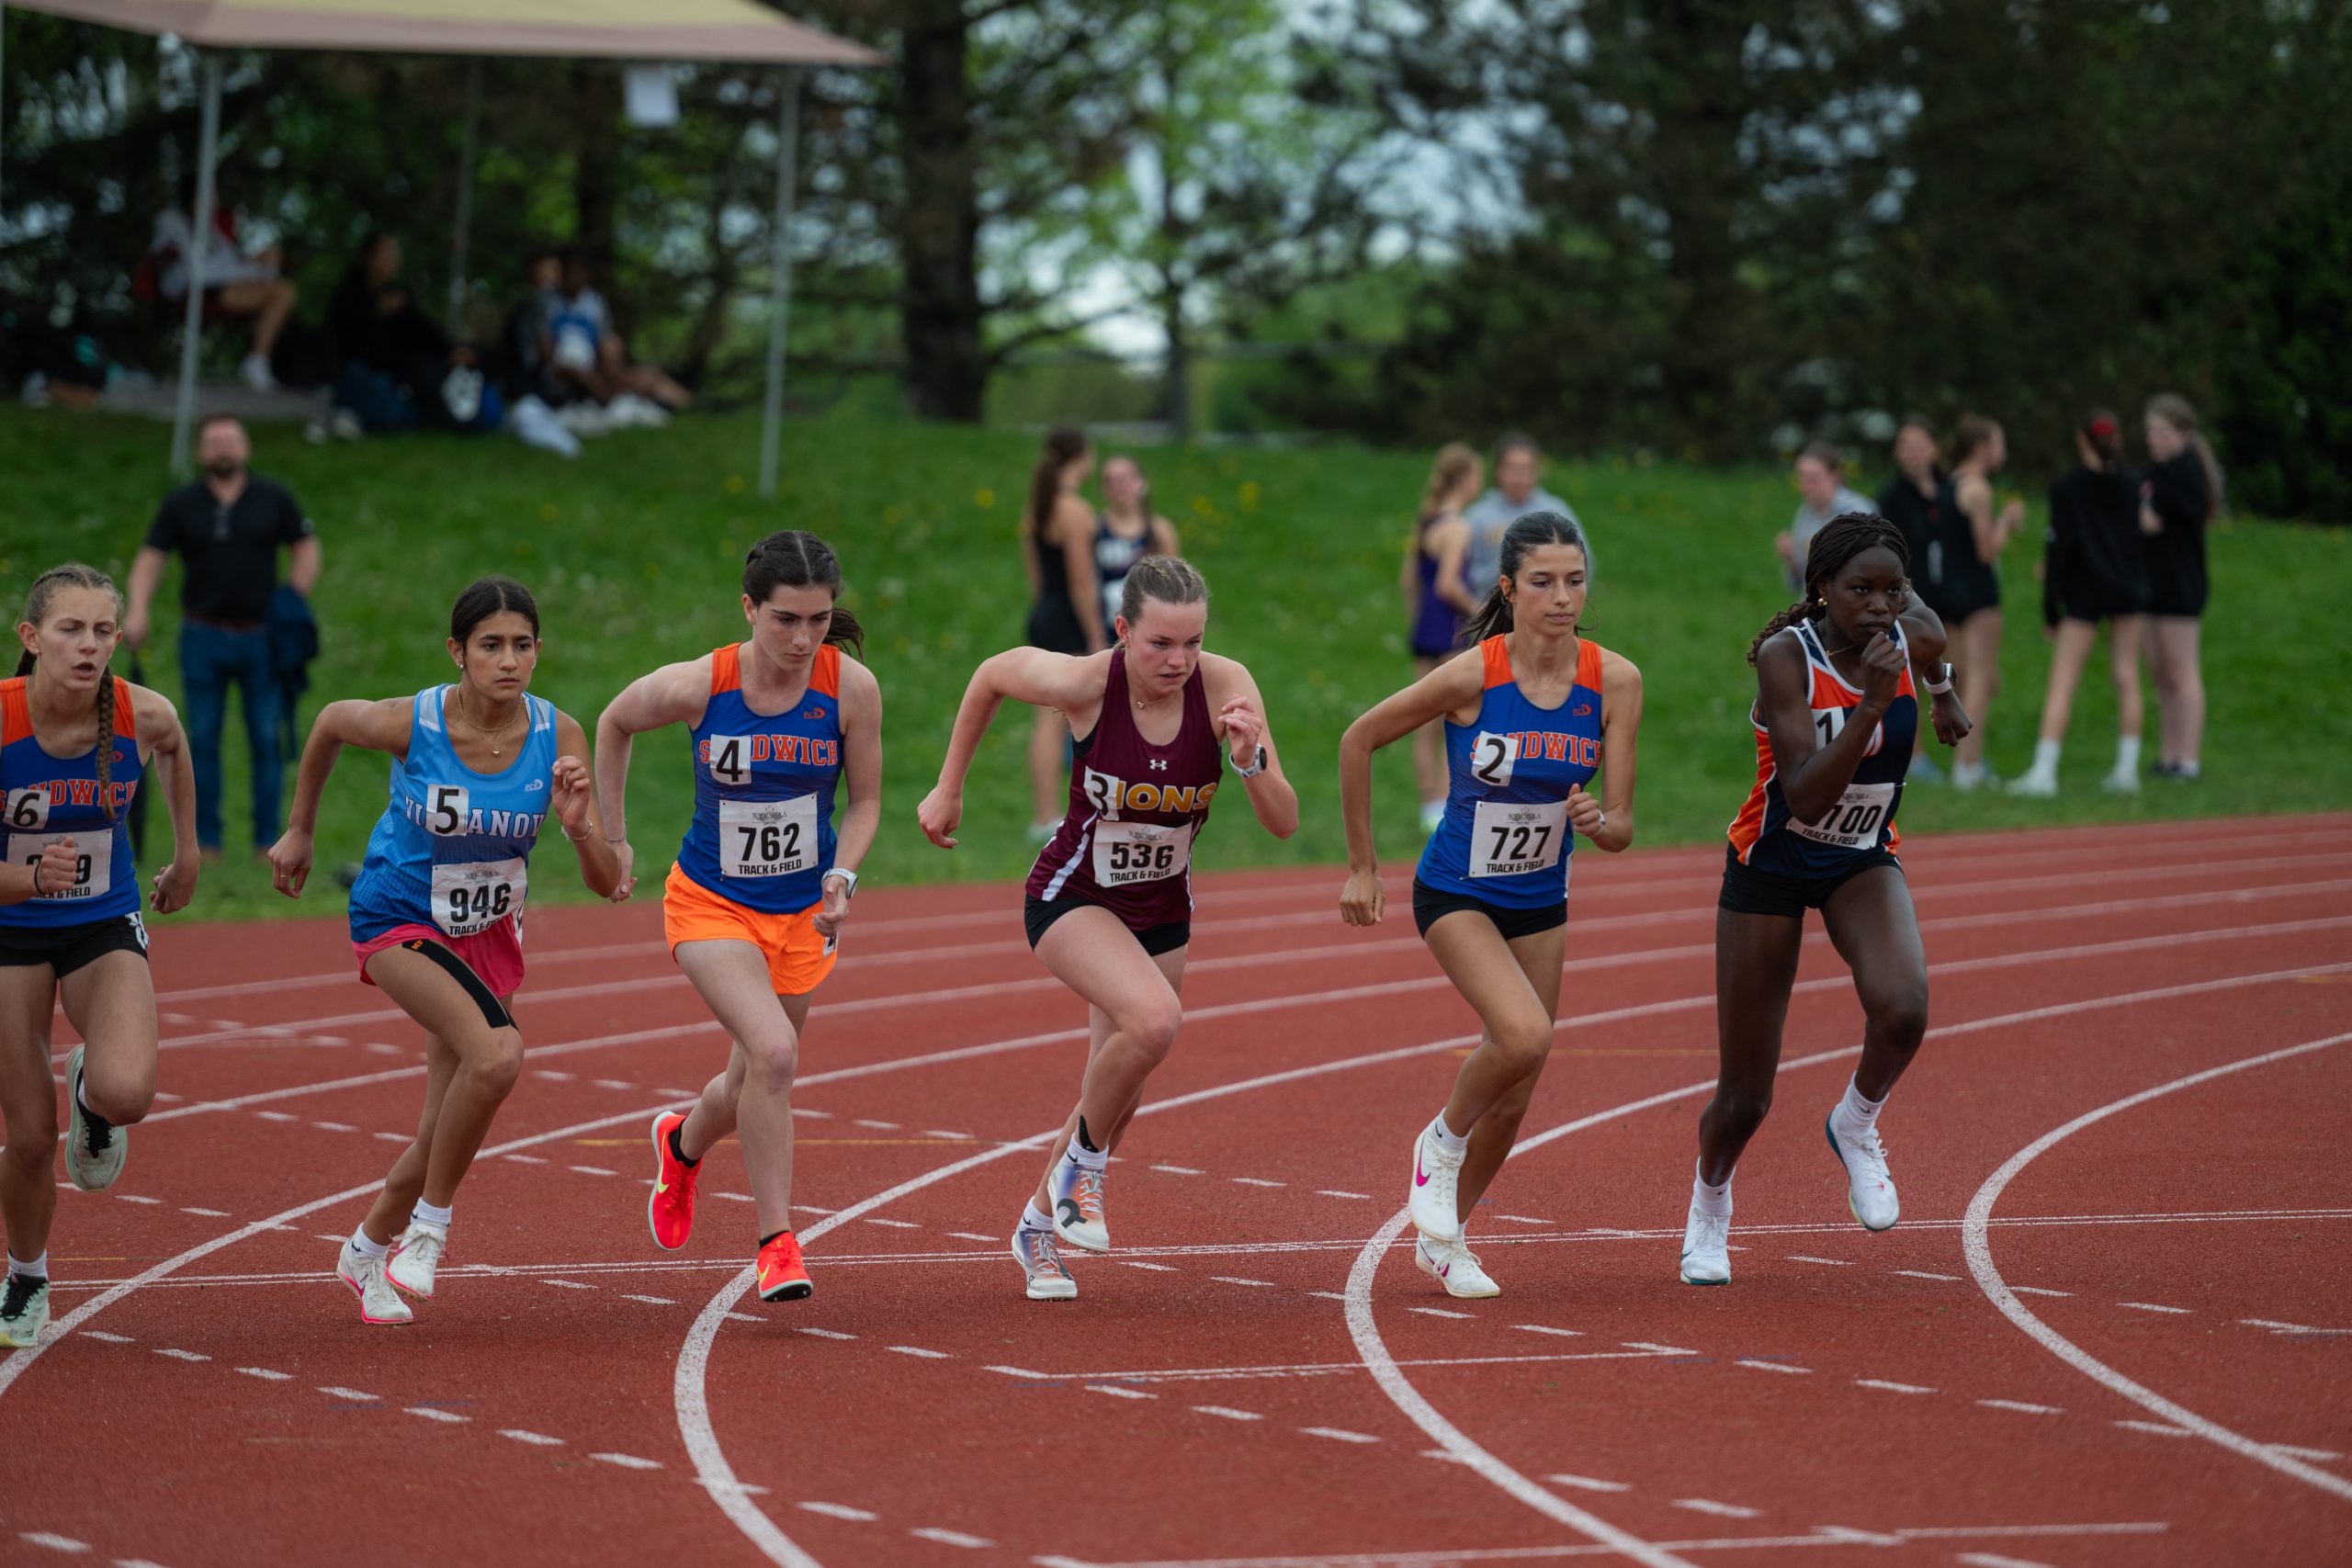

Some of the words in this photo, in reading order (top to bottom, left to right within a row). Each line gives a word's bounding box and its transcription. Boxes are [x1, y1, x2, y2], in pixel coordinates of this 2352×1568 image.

[1816, 711, 1833, 746] 1
[699, 734, 838, 766] SDWICH
[716, 739, 743, 783] 4
[1477, 738, 1507, 784] 2
[13, 792, 41, 828] 6
[435, 787, 459, 834] 5
[1091, 773, 1109, 817] 3
[1115, 781, 1217, 813] IONS
[1823, 804, 1883, 834] 100
[738, 822, 801, 862] 762
[1490, 825, 1552, 860] 727
[1803, 828, 1830, 842] TRACK
[1829, 834, 1838, 843] &
[1838, 837, 1860, 845] FIELD
[738, 864, 769, 874] TRACK
[771, 863, 778, 874] &
[779, 859, 802, 872] FIELD
[1110, 841, 1174, 870] 536
[1487, 863, 1515, 874] TRACK
[1516, 863, 1522, 872] &
[1523, 859, 1545, 872] FIELD
[1110, 871, 1138, 883] TRACK
[1139, 870, 1147, 879] &
[1148, 868, 1170, 879] FIELD
[57, 889, 65, 898] &
[66, 886, 91, 898] FIELD
[449, 882, 512, 923] 946
[448, 924, 478, 935] TRACK
